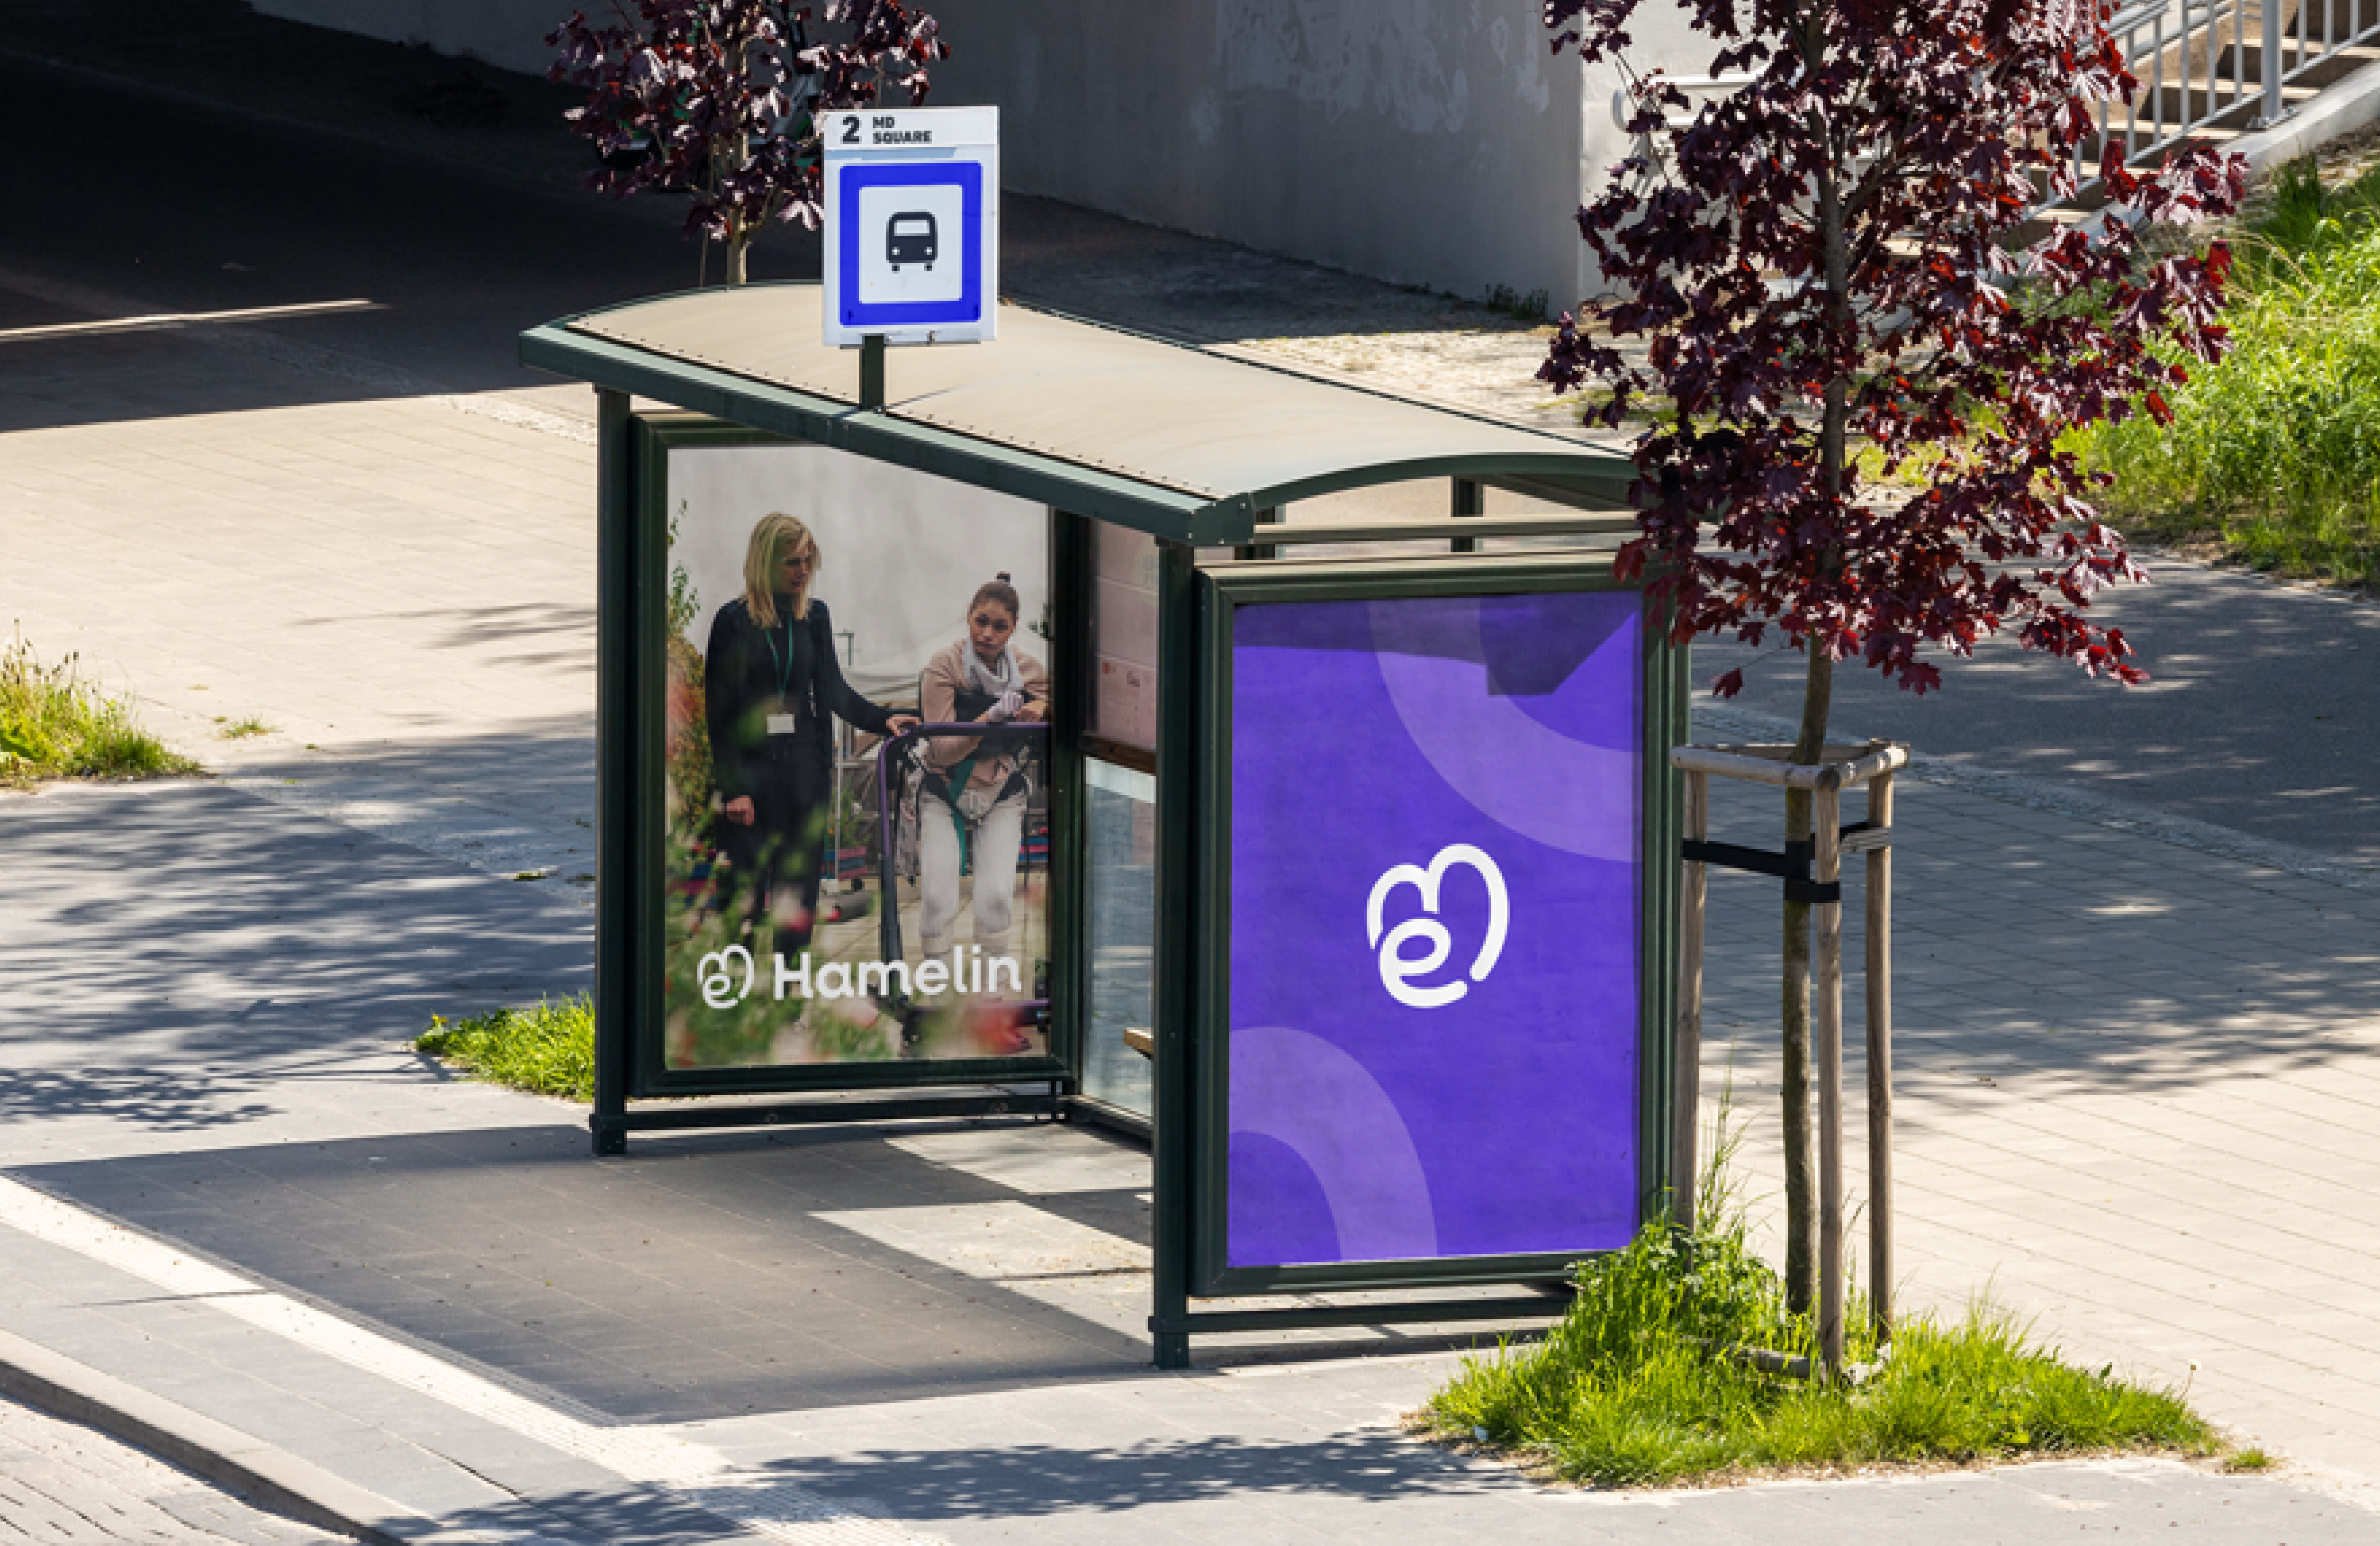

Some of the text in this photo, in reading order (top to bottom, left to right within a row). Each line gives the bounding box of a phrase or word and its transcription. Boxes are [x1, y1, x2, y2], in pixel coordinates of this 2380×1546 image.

[842, 116, 862, 145] 2
[872, 116, 896, 128] MD
[872, 130, 932, 145] SQUARE
[774, 944, 1022, 1001] Hamelin
